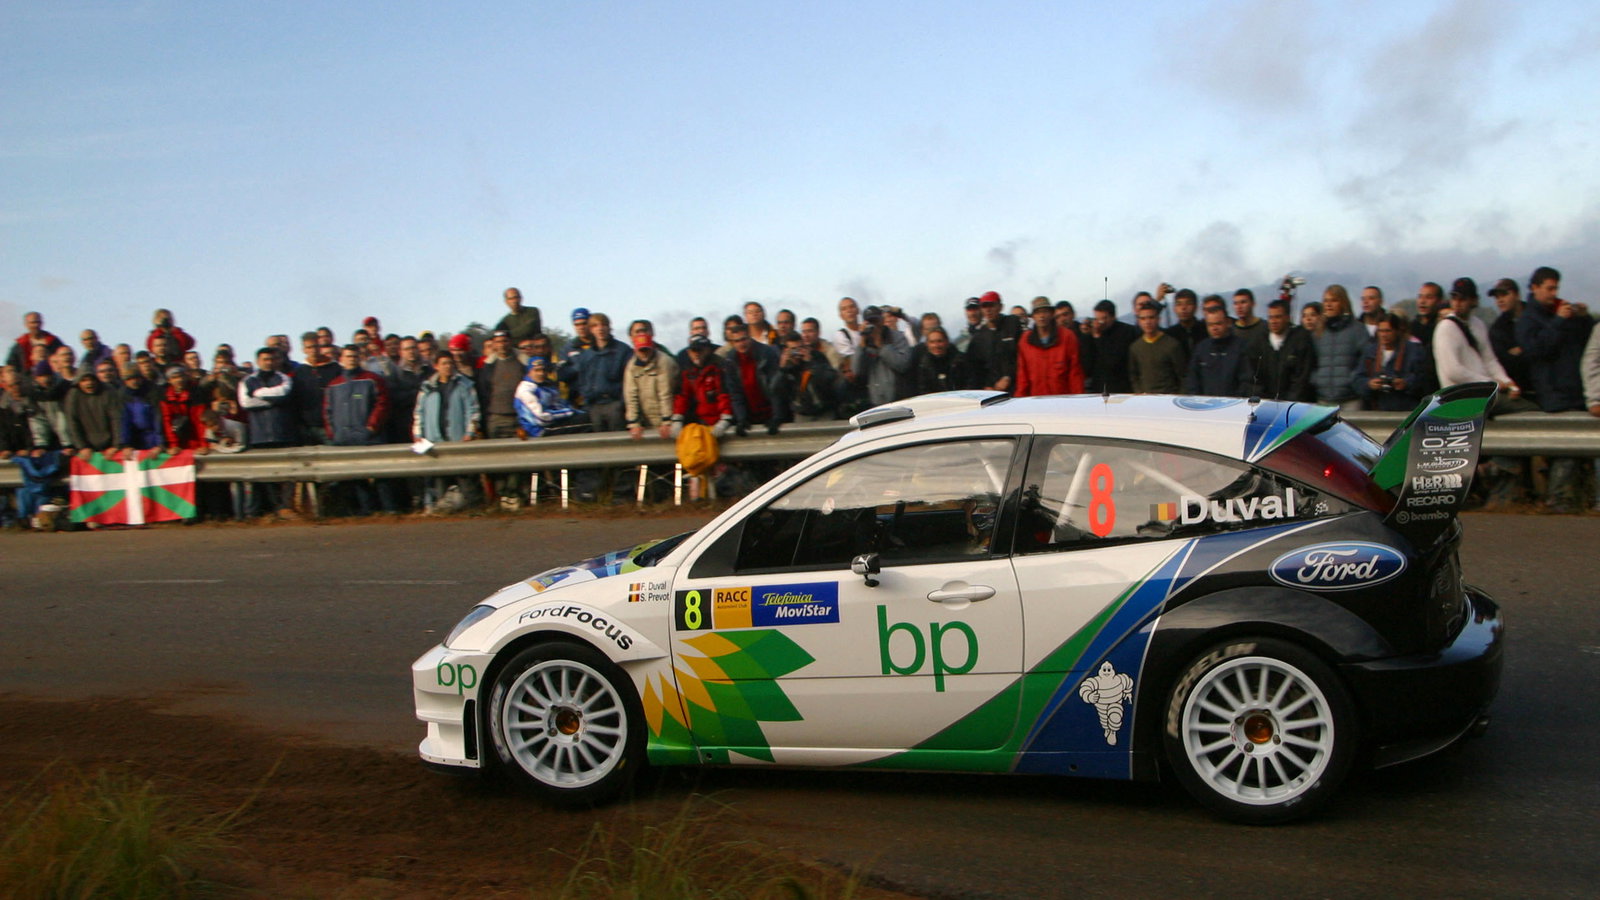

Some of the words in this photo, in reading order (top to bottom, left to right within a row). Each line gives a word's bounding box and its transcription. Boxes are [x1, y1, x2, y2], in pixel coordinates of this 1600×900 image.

[1428, 423, 1471, 432] CHAMPION
[1412, 475, 1442, 490] H&R
[1089, 463, 1116, 537] 8
[1180, 487, 1296, 525] Duval
[1406, 494, 1456, 507] RECARO
[1410, 510, 1450, 521] brembo
[1297, 548, 1380, 582] Ford
[641, 582, 647, 591] F.
[648, 581, 667, 590] Duval
[640, 592, 647, 602] S.
[648, 592, 670, 601] Prevot
[717, 591, 748, 603] RACC
[684, 590, 703, 630] 8
[775, 605, 832, 618] MoviStar
[877, 605, 979, 692] bp
[436, 656, 478, 695] bp
